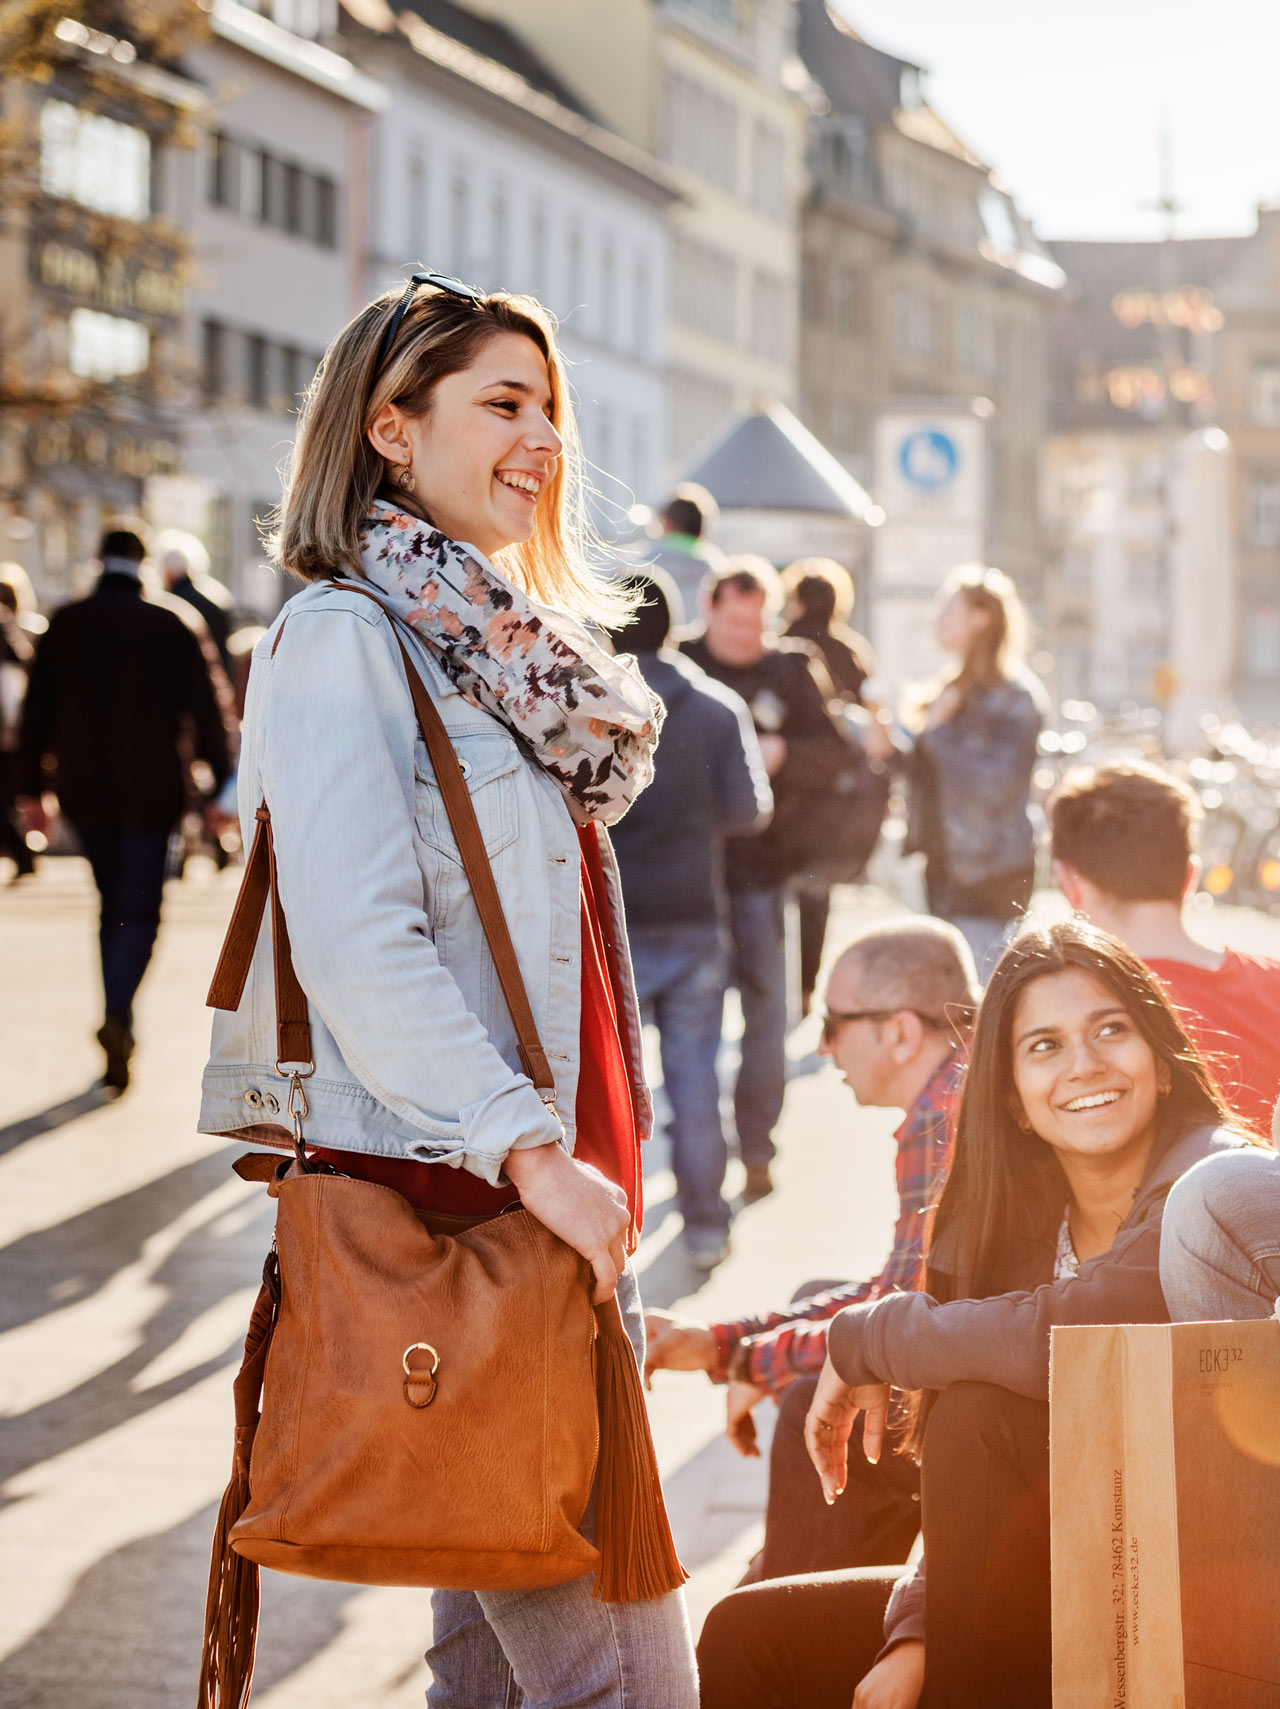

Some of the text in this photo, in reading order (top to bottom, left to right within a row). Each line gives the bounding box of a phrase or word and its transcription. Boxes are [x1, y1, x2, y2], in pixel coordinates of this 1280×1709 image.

[1111, 1468, 1123, 1533] Konstanz
[1111, 1537, 1124, 1580] 78462
[1130, 1536, 1140, 1646] www.ecke32.de
